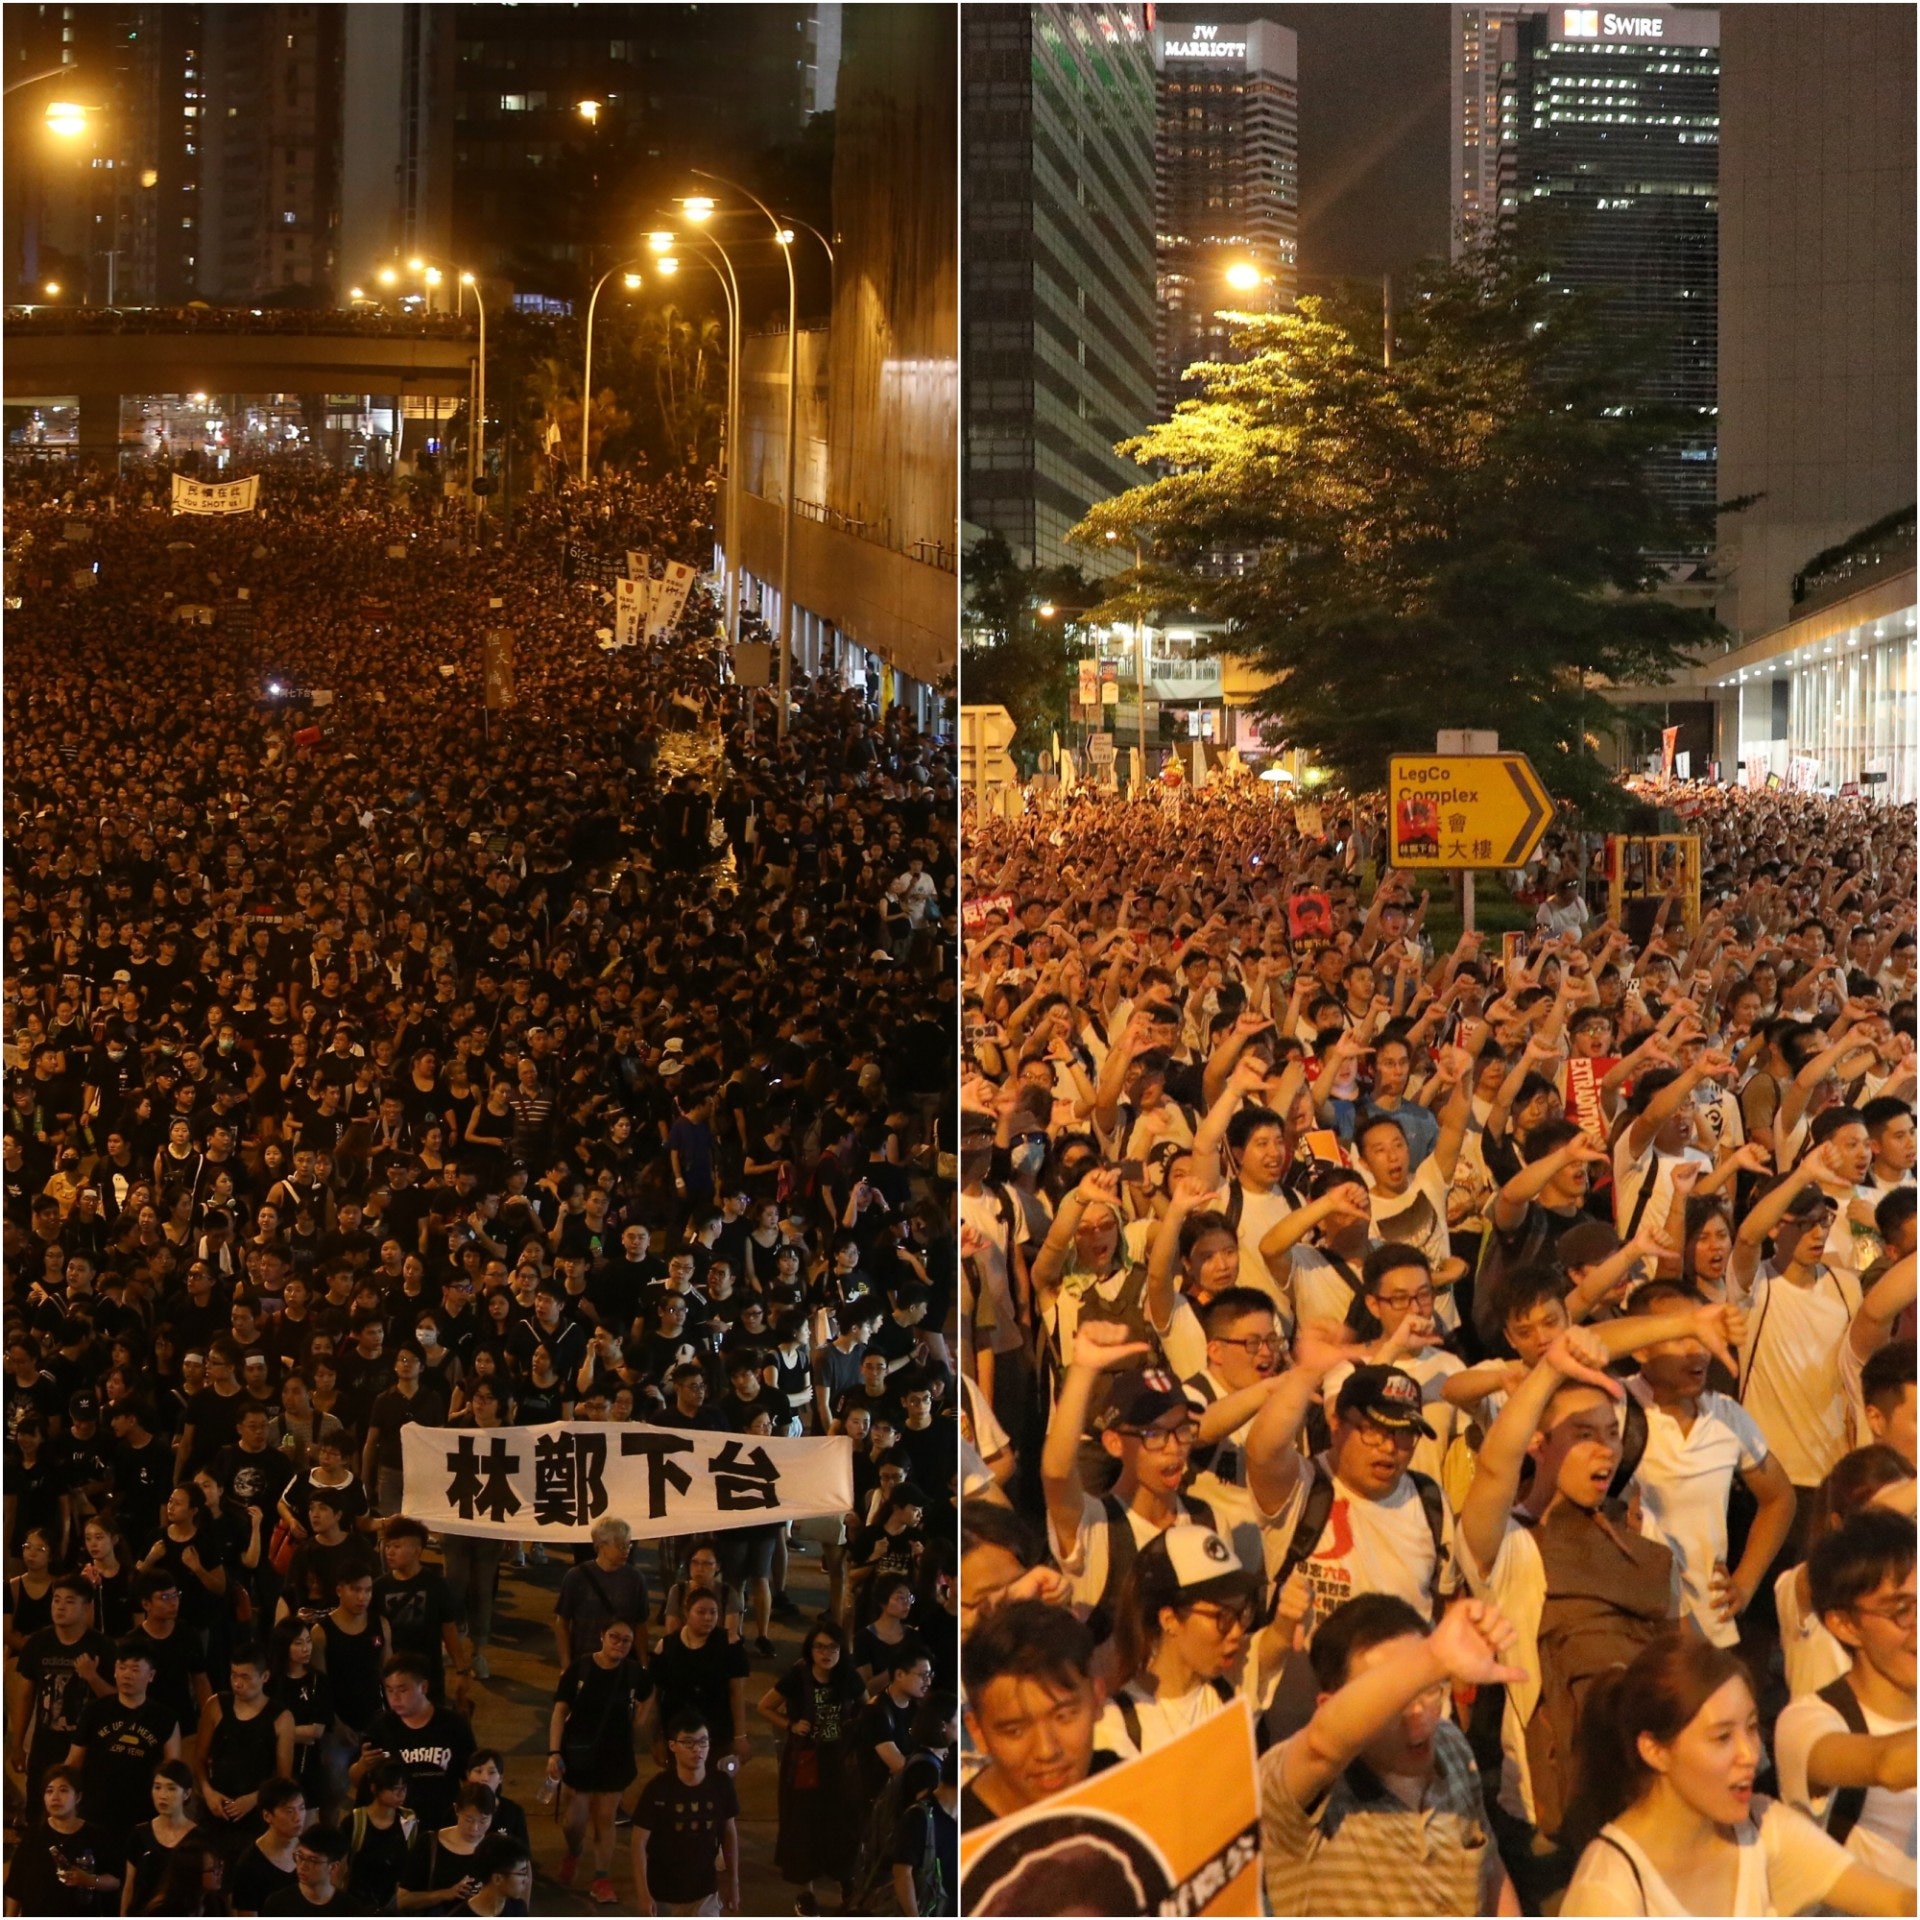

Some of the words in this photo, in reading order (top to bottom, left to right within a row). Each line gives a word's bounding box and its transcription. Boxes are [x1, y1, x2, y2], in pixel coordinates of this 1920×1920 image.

[1192, 25, 1218, 40] JW
[1603, 13, 1663, 37] SWIRE
[1165, 41, 1246, 57] MARRIOTT
[201, 500, 225, 508] SHOT
[1399, 766, 1450, 783] LegCo
[1399, 787, 1478, 805] Complex
[1438, 839, 1492, 860] 大樓
[445, 1431, 781, 1527] 林鄭下台
[400, 1746, 452, 1771] RASHER
